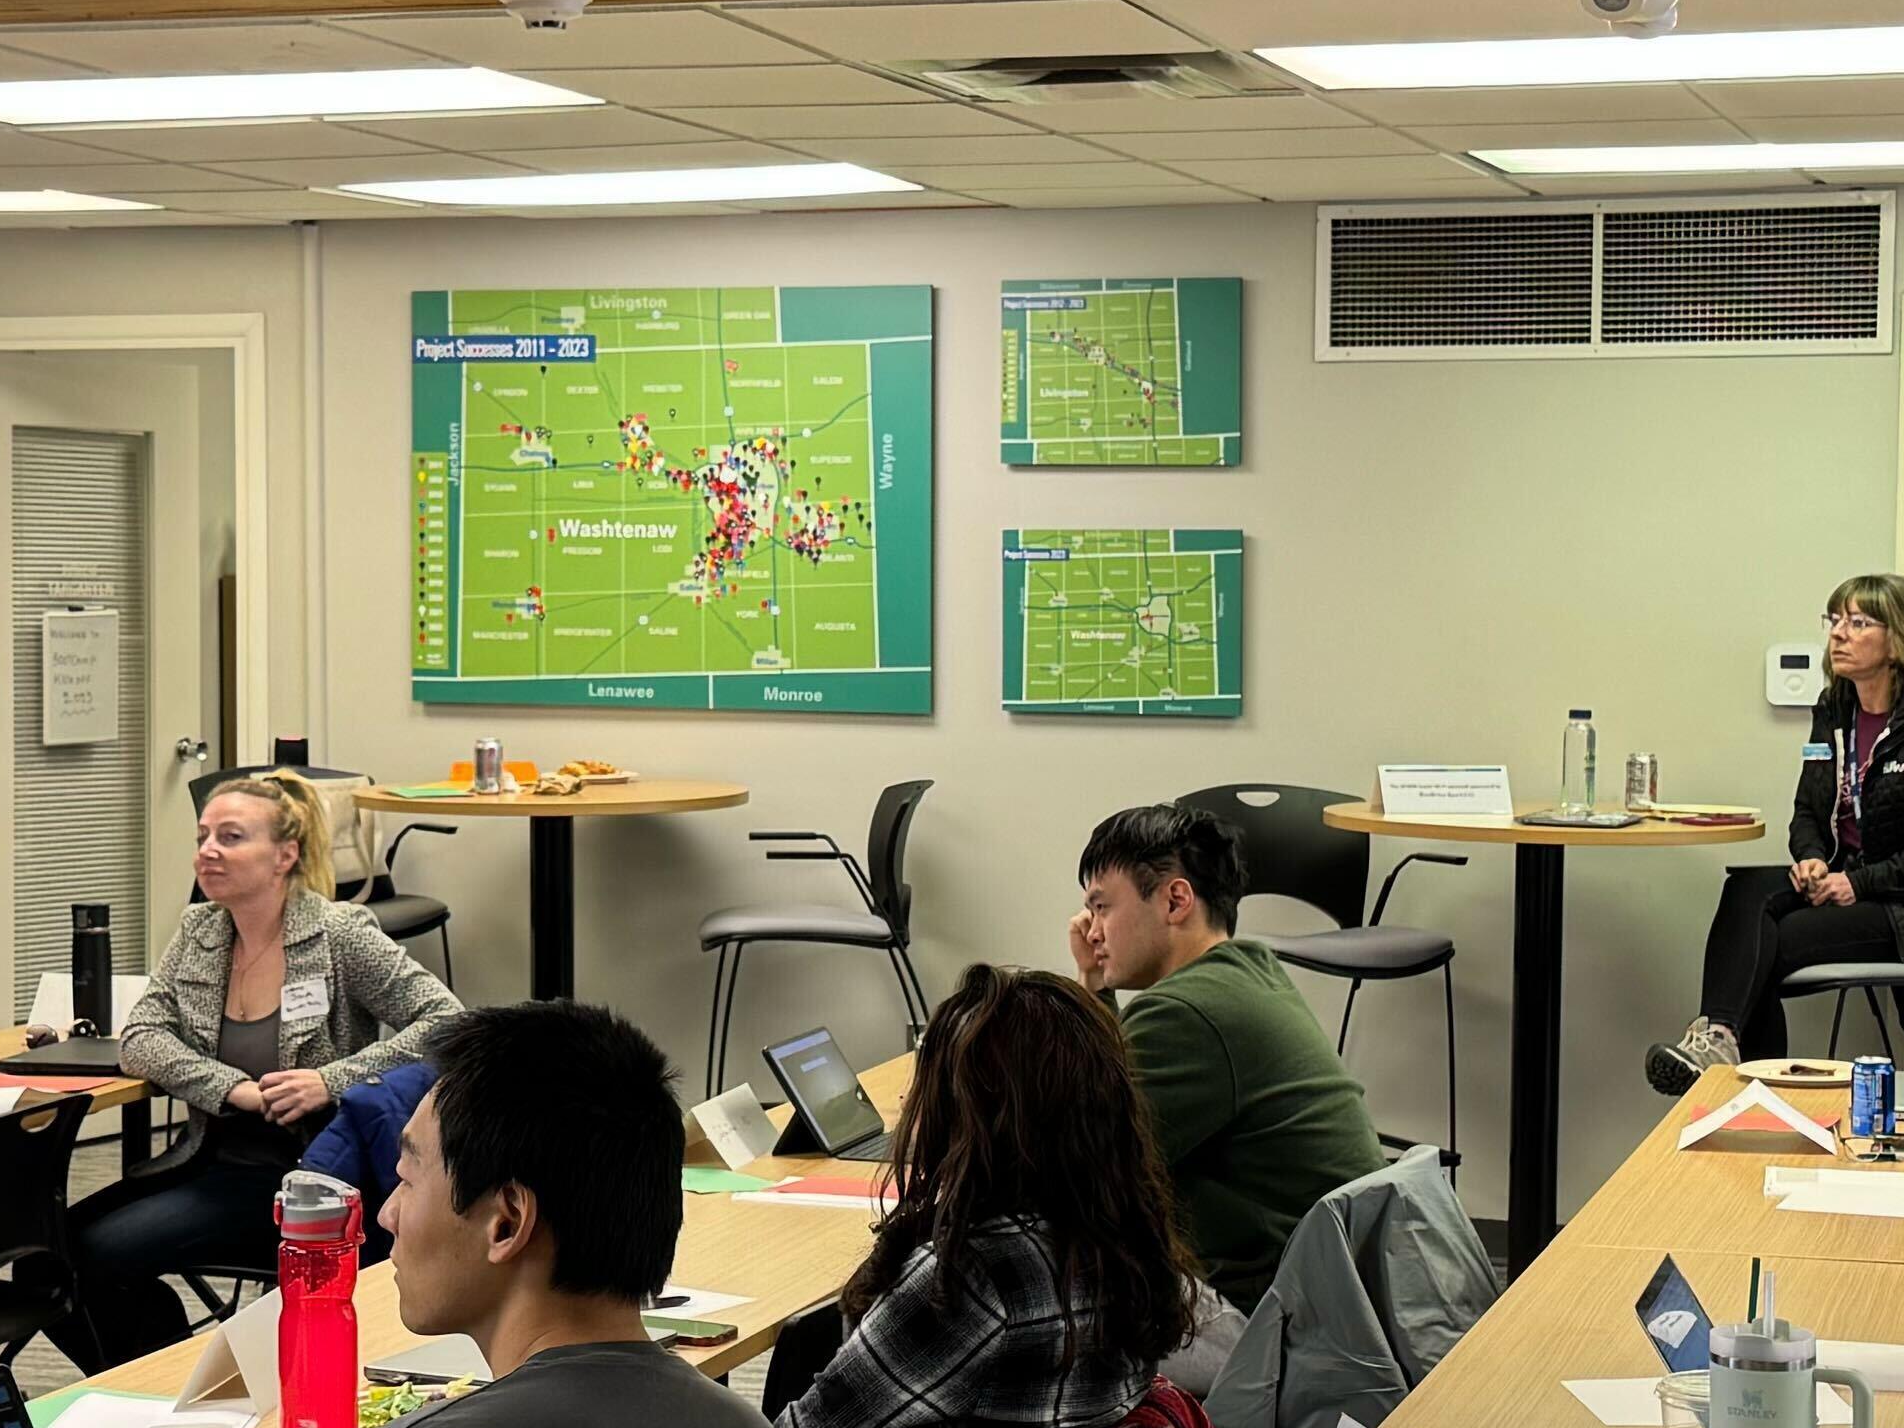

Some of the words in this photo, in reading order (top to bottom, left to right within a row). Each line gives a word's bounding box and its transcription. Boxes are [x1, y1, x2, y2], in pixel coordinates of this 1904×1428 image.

[591, 296, 667, 312] Livingston
[416, 339, 455, 361] Project
[456, 340, 513, 358] Successes
[515, 339, 545, 358] 2011
[558, 339, 589, 357] 2023
[448, 422, 459, 486] Jackson
[879, 433, 893, 489] Wayne
[559, 520, 677, 539] Washtenaw
[588, 683, 654, 699] Lenawee
[763, 687, 823, 703] Monroe
